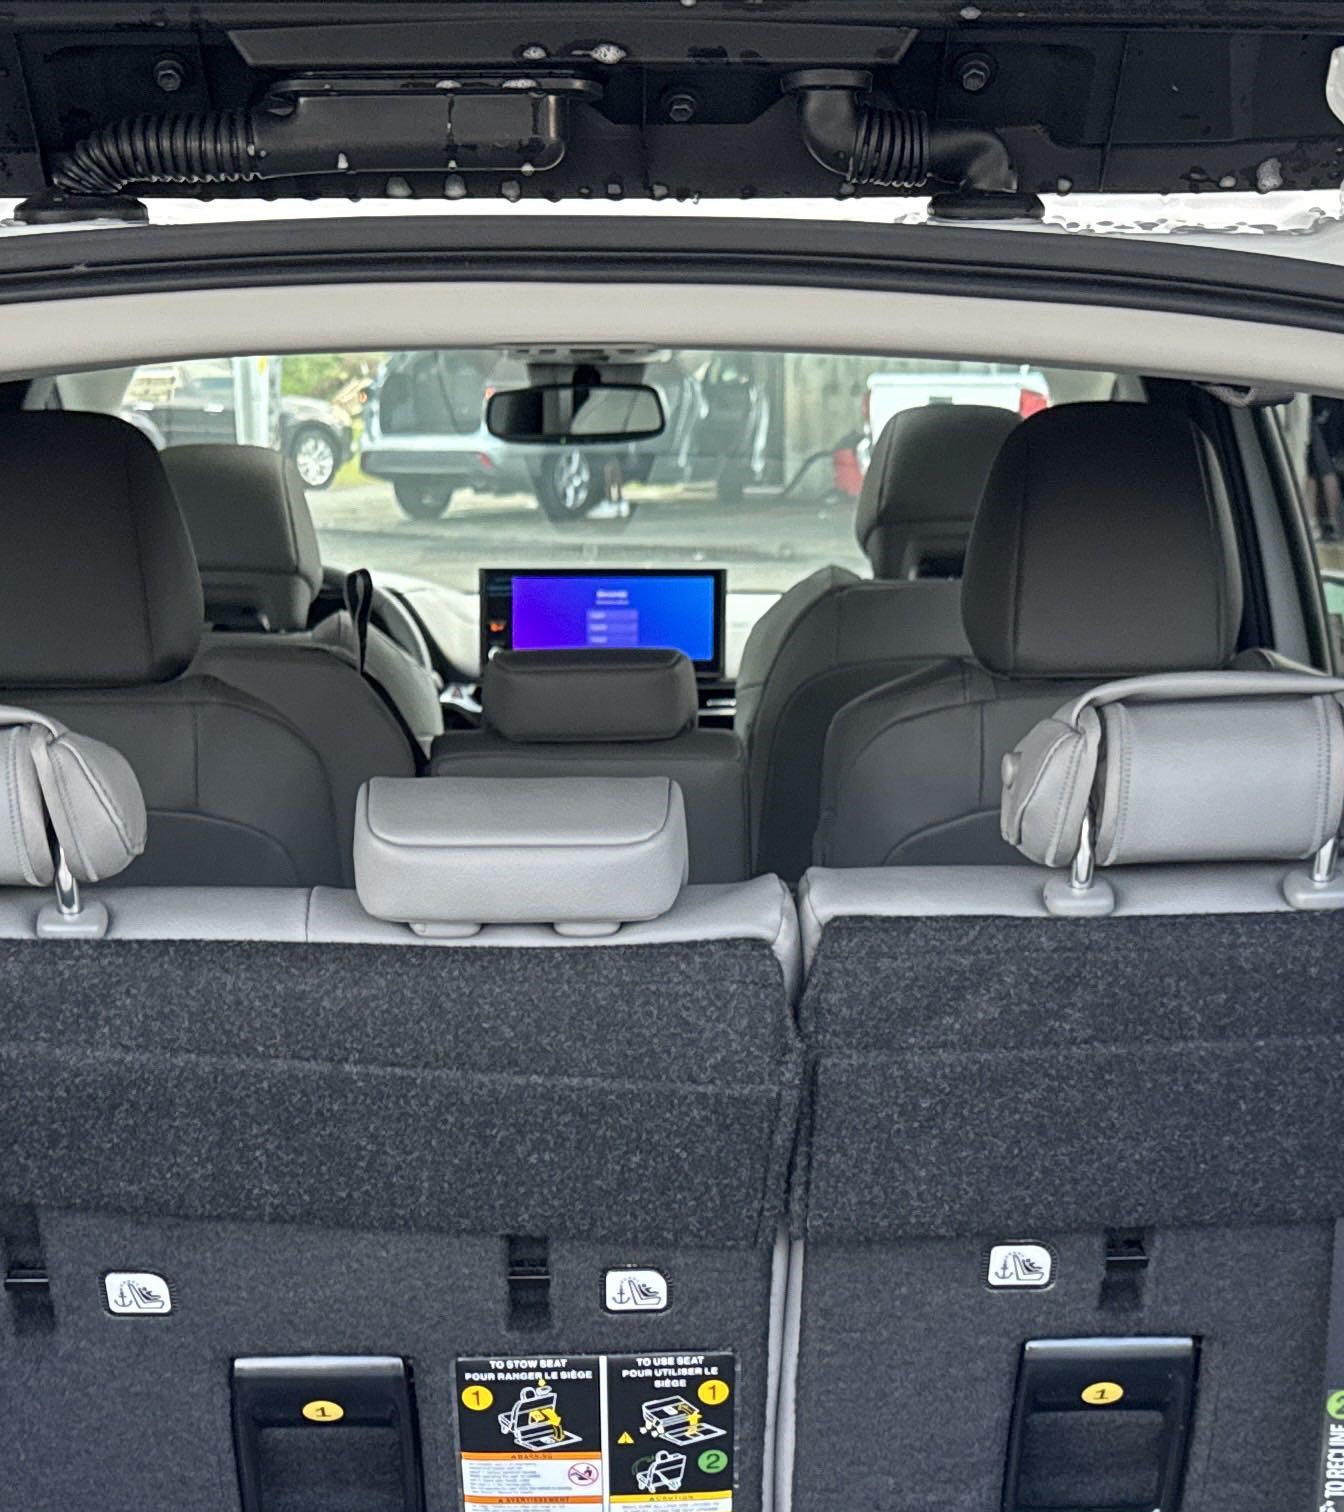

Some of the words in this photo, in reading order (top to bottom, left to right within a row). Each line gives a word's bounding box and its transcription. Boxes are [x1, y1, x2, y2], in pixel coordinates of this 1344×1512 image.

[489, 1360, 504, 1369] TO
[506, 1360, 537, 1369] STOW
[539, 1359, 567, 1369] SEAT
[636, 1358, 651, 1367] TO
[653, 1357, 675, 1366] USE
[676, 1356, 704, 1366] SEAT
[465, 1372, 495, 1381] POUR
[497, 1371, 543, 1380] RANGER
[544, 1371, 558, 1380] LE
[560, 1369, 593, 1379] SIÈGE
[622, 1369, 653, 1378] POUR
[654, 1367, 703, 1377] UTILISER
[704, 1367, 718, 1375] LE
[654, 1378, 687, 1388] SIÈGE
[471, 1390, 481, 1406] 1
[708, 1385, 716, 1401] 1
[706, 1453, 721, 1470] 2
